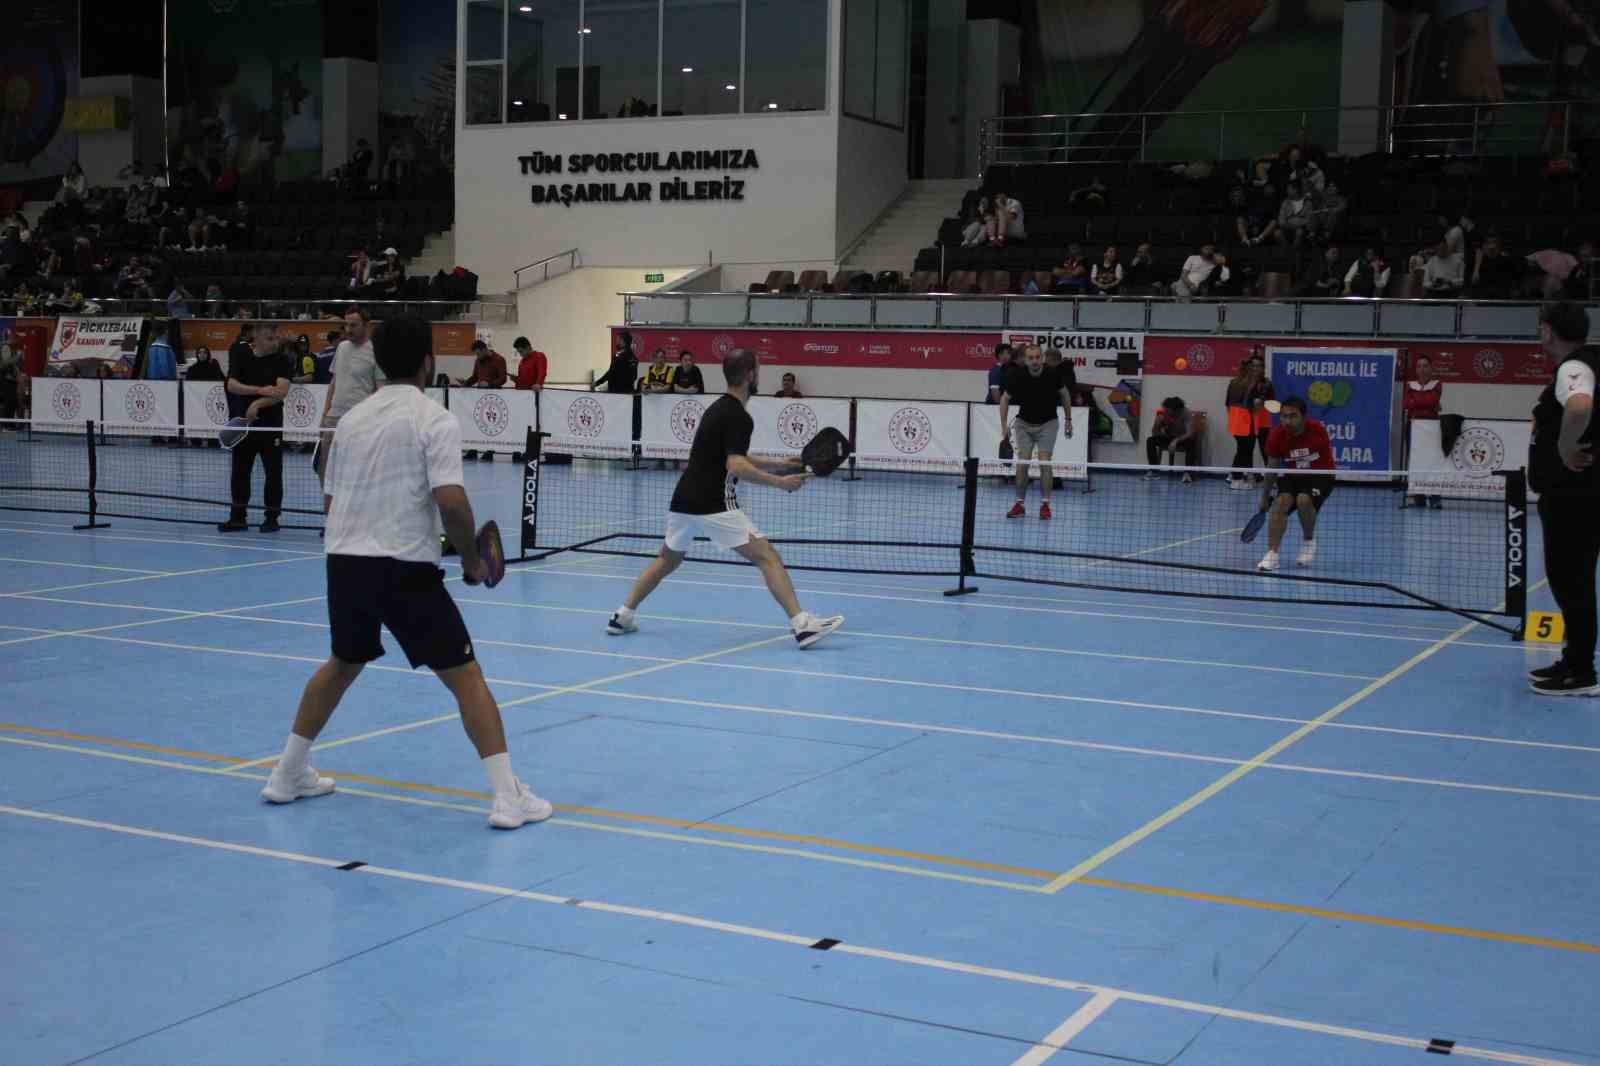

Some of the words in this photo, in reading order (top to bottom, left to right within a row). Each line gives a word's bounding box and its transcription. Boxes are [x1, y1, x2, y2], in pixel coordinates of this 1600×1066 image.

[518, 151, 562, 175] TÜM
[568, 149, 759, 173] SPORCULARIMIZA
[531, 182, 652, 207] BAŞARILAR
[659, 176, 746, 202] DİLERİZ
[1286, 360, 1357, 377] PICKLEBALL
[1359, 359, 1378, 377] İLE
[1331, 446, 1374, 464] LARA
[524, 458, 539, 513] JOOLA
[1507, 523, 1523, 589] JOOLA
[1536, 615, 1553, 638] 5
